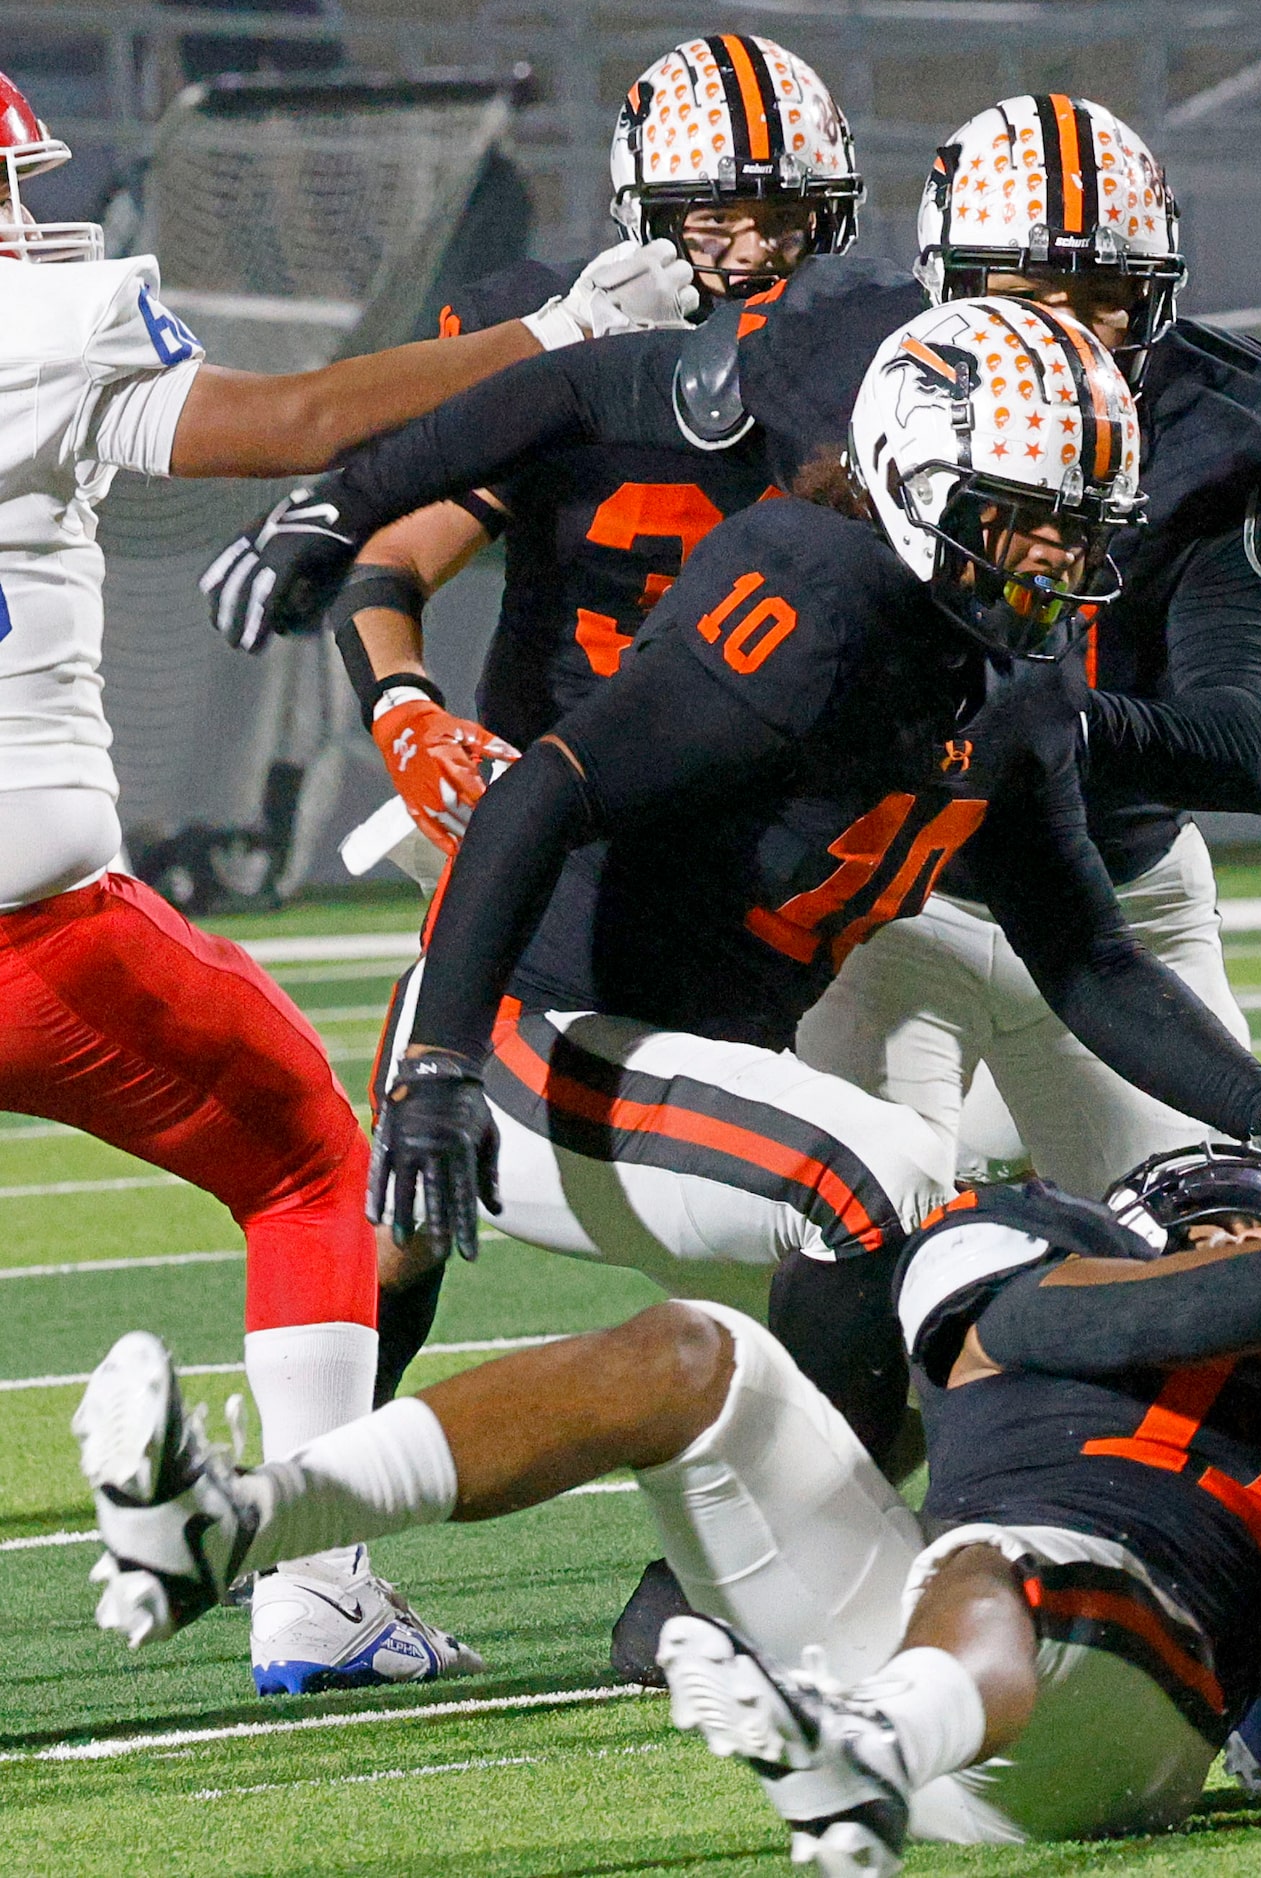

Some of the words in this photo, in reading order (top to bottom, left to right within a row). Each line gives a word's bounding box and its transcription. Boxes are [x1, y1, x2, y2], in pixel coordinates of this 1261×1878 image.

[696, 571, 797, 675] 10
[744, 791, 988, 974] 10
[381, 1638, 424, 1659] ALPHA
